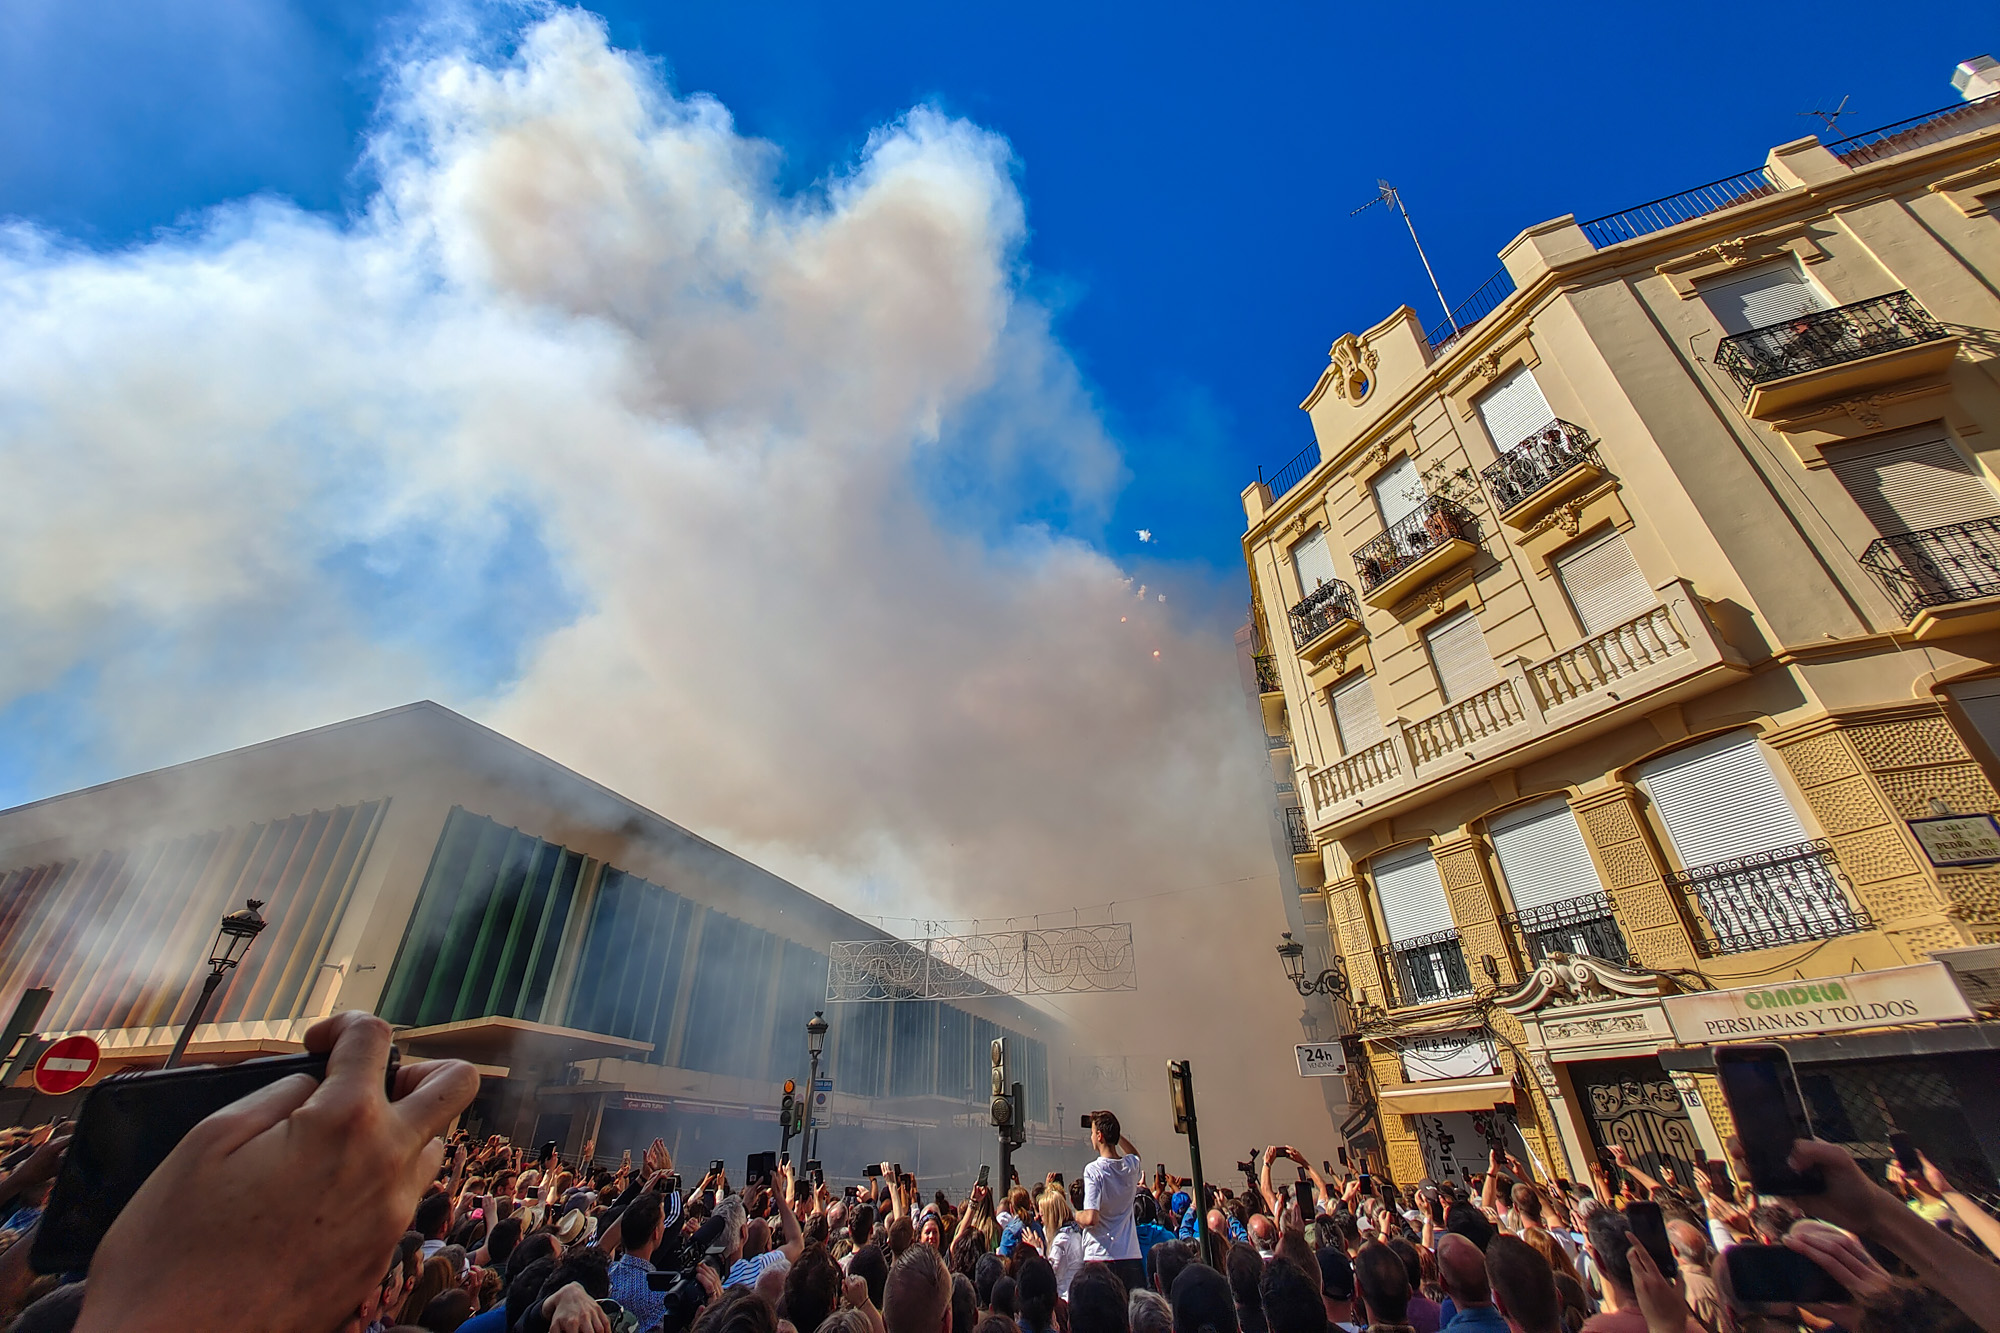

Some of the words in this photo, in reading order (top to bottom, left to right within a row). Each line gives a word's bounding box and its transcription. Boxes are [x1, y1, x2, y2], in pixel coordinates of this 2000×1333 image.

[1936, 823, 1970, 833] CALLE
[1950, 832, 1963, 840] DE
[1935, 840, 1973, 850] PEDRO
[1939, 852, 1956, 860] EL
[1959, 848, 2000, 859] GRANDE
[1745, 982, 1847, 1010] CANDELA
[1704, 1011, 1808, 1035] PERSIANAS
[1810, 1010, 1826, 1025] Y
[1828, 999, 1919, 1023] TOLDOS
[1413, 1039, 1429, 1052] Fill
[1432, 1039, 1440, 1050] &
[1304, 1048, 1333, 1062] 24h
[1307, 1061, 1335, 1069] VENDING
[1685, 1091, 1700, 1106] 13
